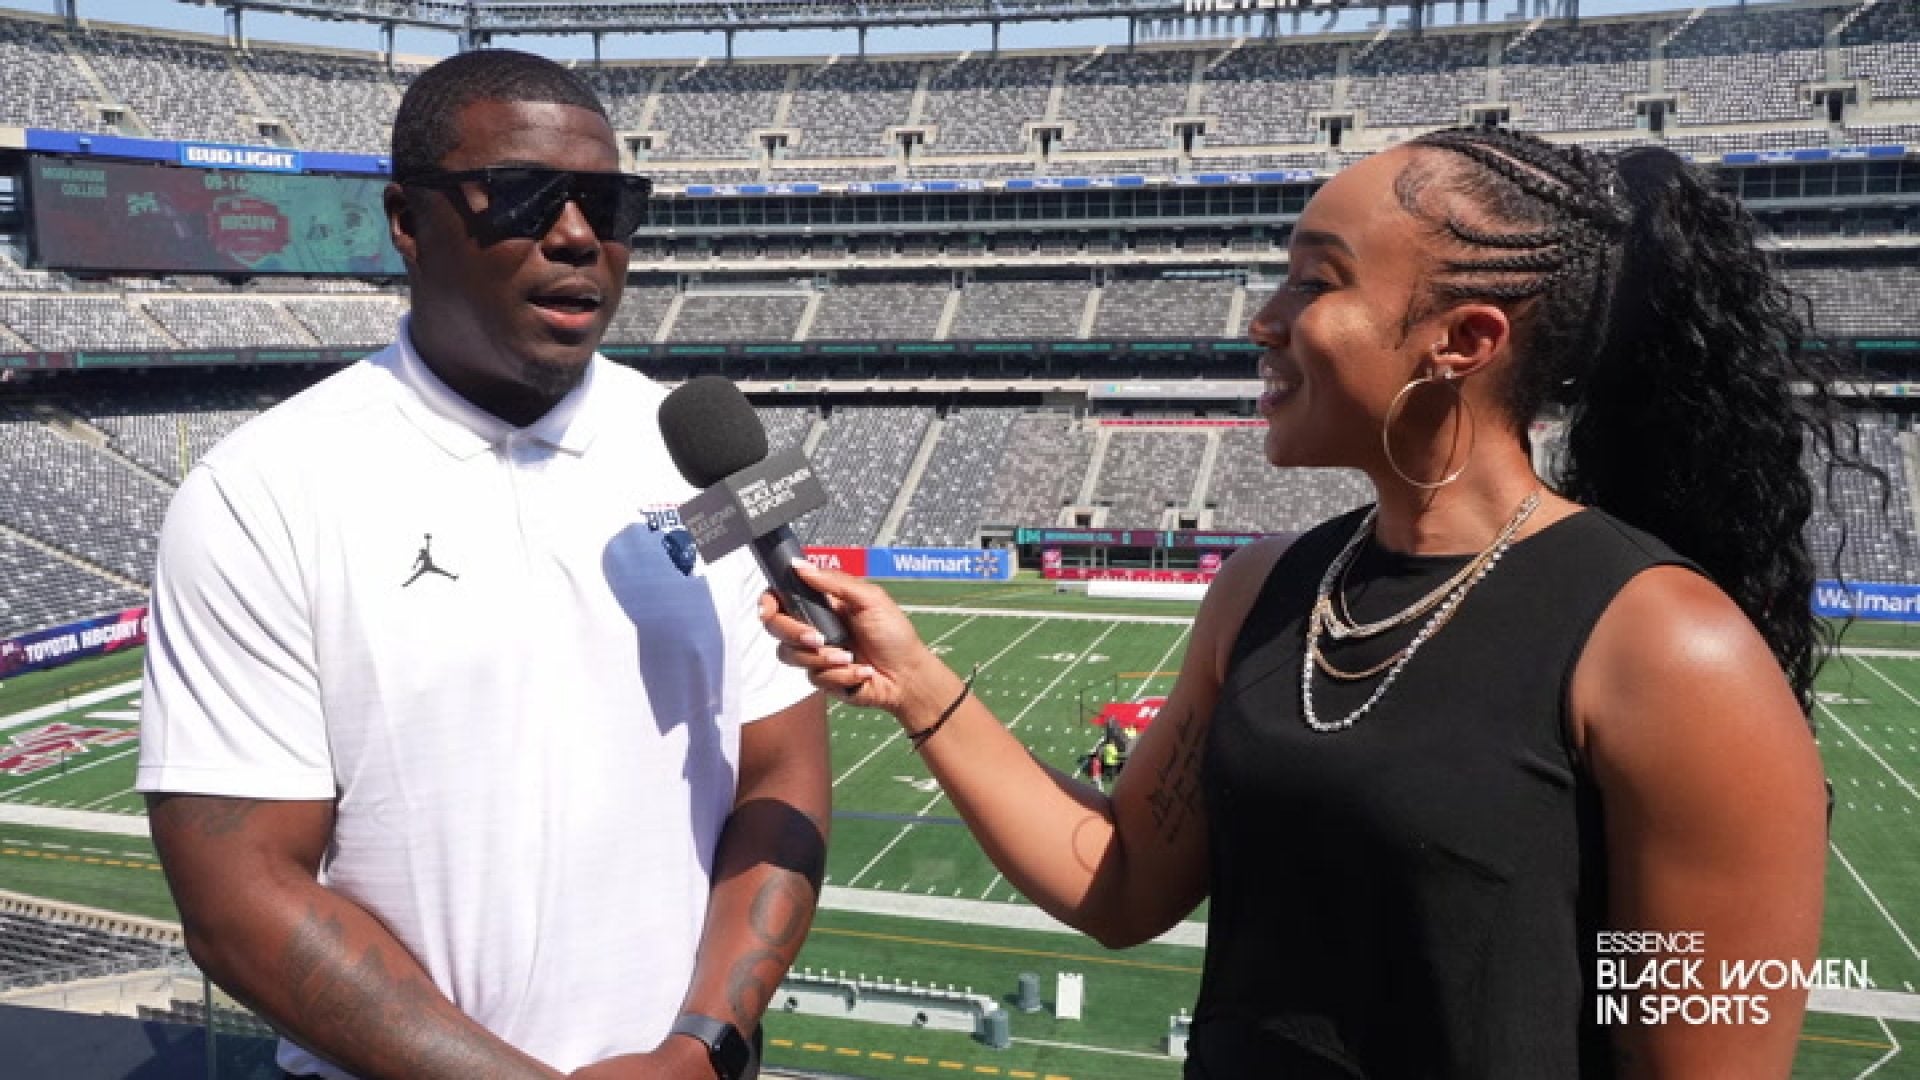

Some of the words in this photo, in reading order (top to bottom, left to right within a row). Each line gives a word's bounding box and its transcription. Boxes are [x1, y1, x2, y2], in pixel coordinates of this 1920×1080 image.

[187, 147, 231, 164] BUD
[233, 150, 294, 169] LIGHT
[892, 551, 972, 574] Walmart
[24, 634, 78, 662] TOYOTA
